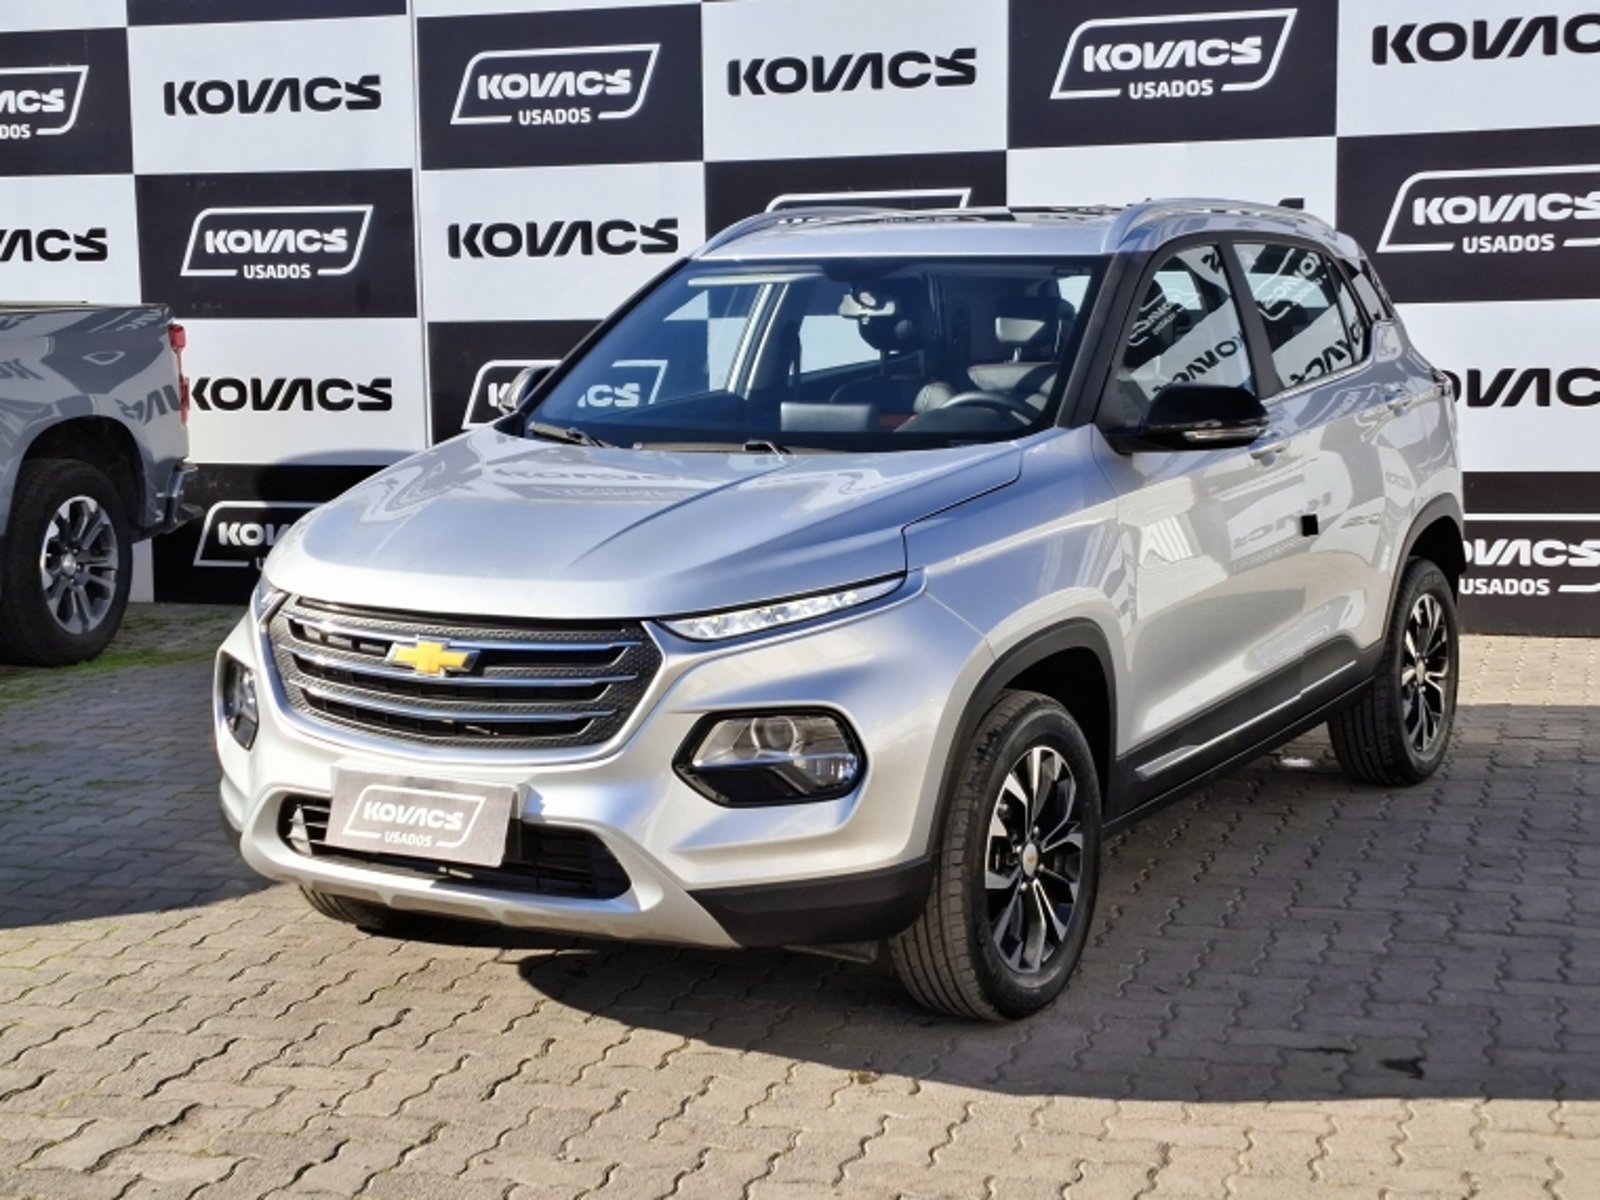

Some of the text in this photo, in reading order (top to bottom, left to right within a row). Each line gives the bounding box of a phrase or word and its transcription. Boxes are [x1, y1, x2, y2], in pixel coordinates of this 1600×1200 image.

[1373, 13, 1600, 66] KOVAC
[1082, 36, 1262, 73] KOVACS
[477, 68, 633, 100] KOVACS
[727, 47, 977, 97] KOVACS
[0, 88, 65, 114] ACS
[163, 74, 382, 116] KOVACS
[1128, 78, 1214, 99] USADOS
[518, 106, 592, 126] USADOS
[0, 123, 31, 140] DOS
[1412, 190, 1600, 226] KOVACS
[0, 227, 108, 263] ACS
[204, 228, 348, 254] KOVACS
[448, 217, 679, 259] KOVACS
[1462, 233, 1555, 254] USADOS
[243, 263, 312, 279] USADOS
[218, 521, 291, 547] KOV
[1463, 538, 1600, 567] VACS
[1458, 578, 1551, 596] USADOS
[363, 801, 464, 831] KOVACS
[384, 831, 433, 848] USADOS
